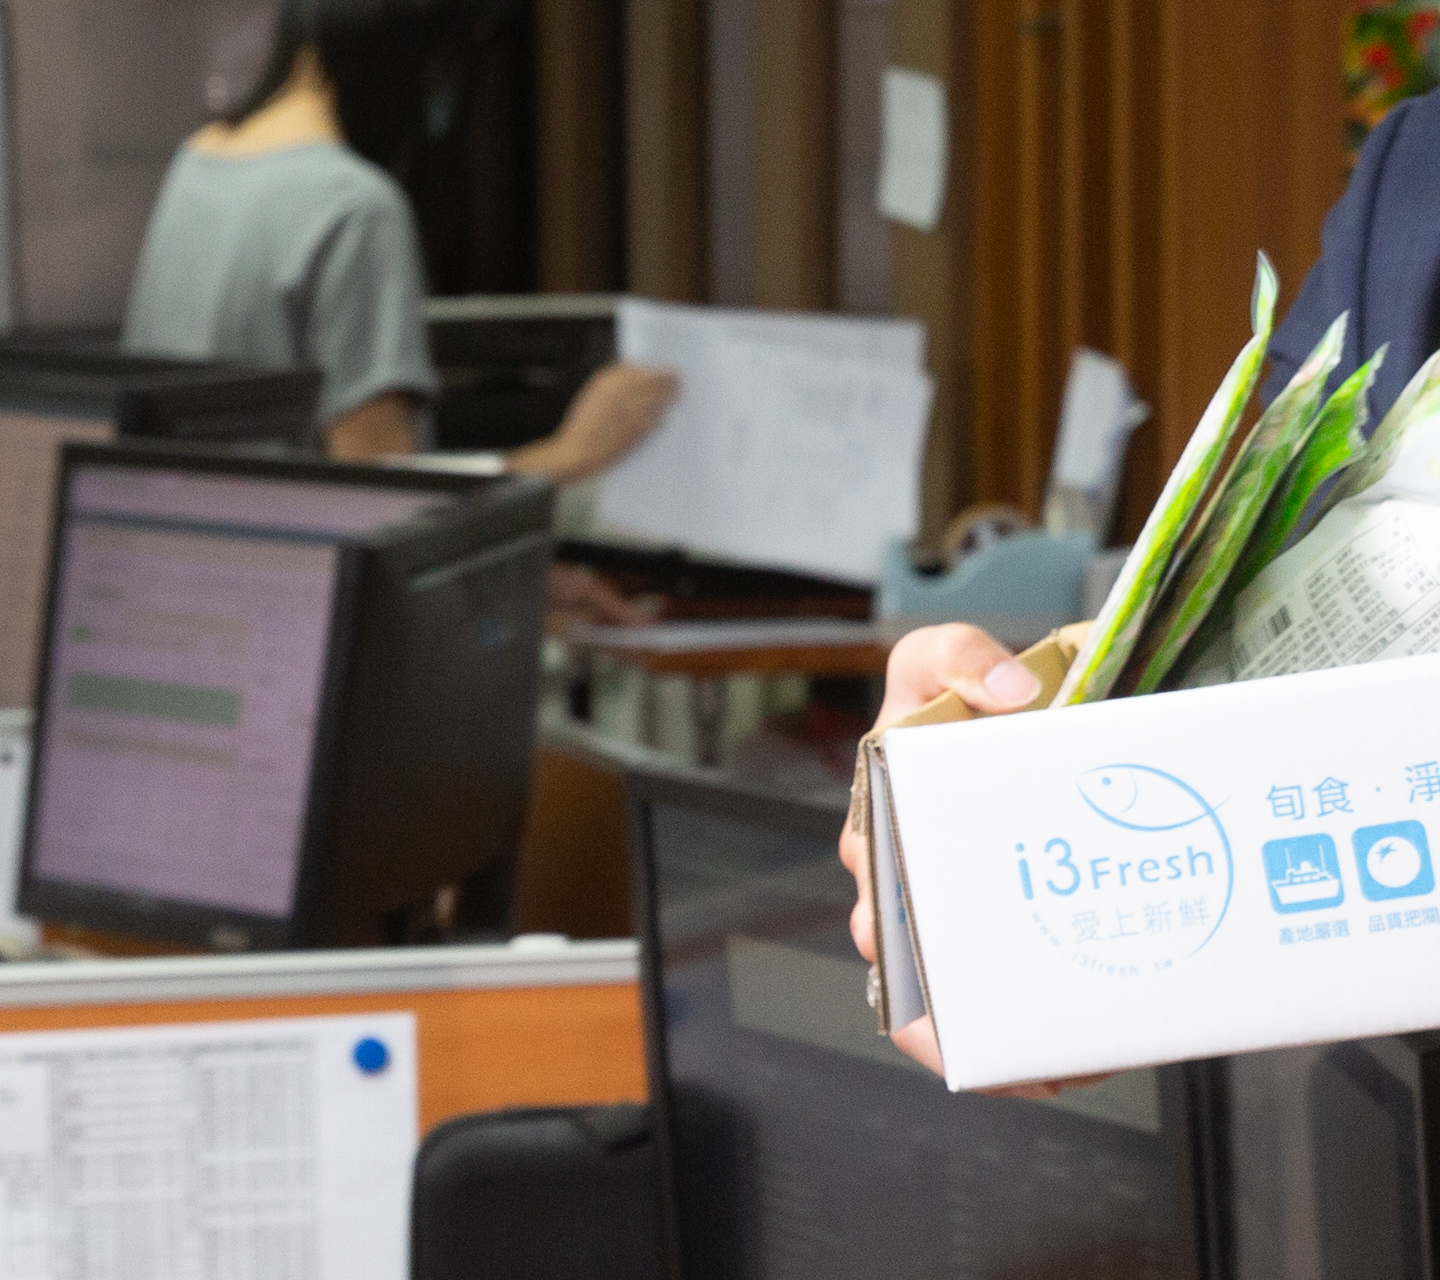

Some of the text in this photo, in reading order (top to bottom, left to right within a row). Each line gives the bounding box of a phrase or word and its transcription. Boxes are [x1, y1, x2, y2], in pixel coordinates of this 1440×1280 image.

[1015, 837, 1214, 901] i3Fresh
[1071, 896, 1209, 945] 愛上新鮮
[1278, 920, 1351, 947] 產地嚴選
[1368, 907, 1440, 933] 品質把關
